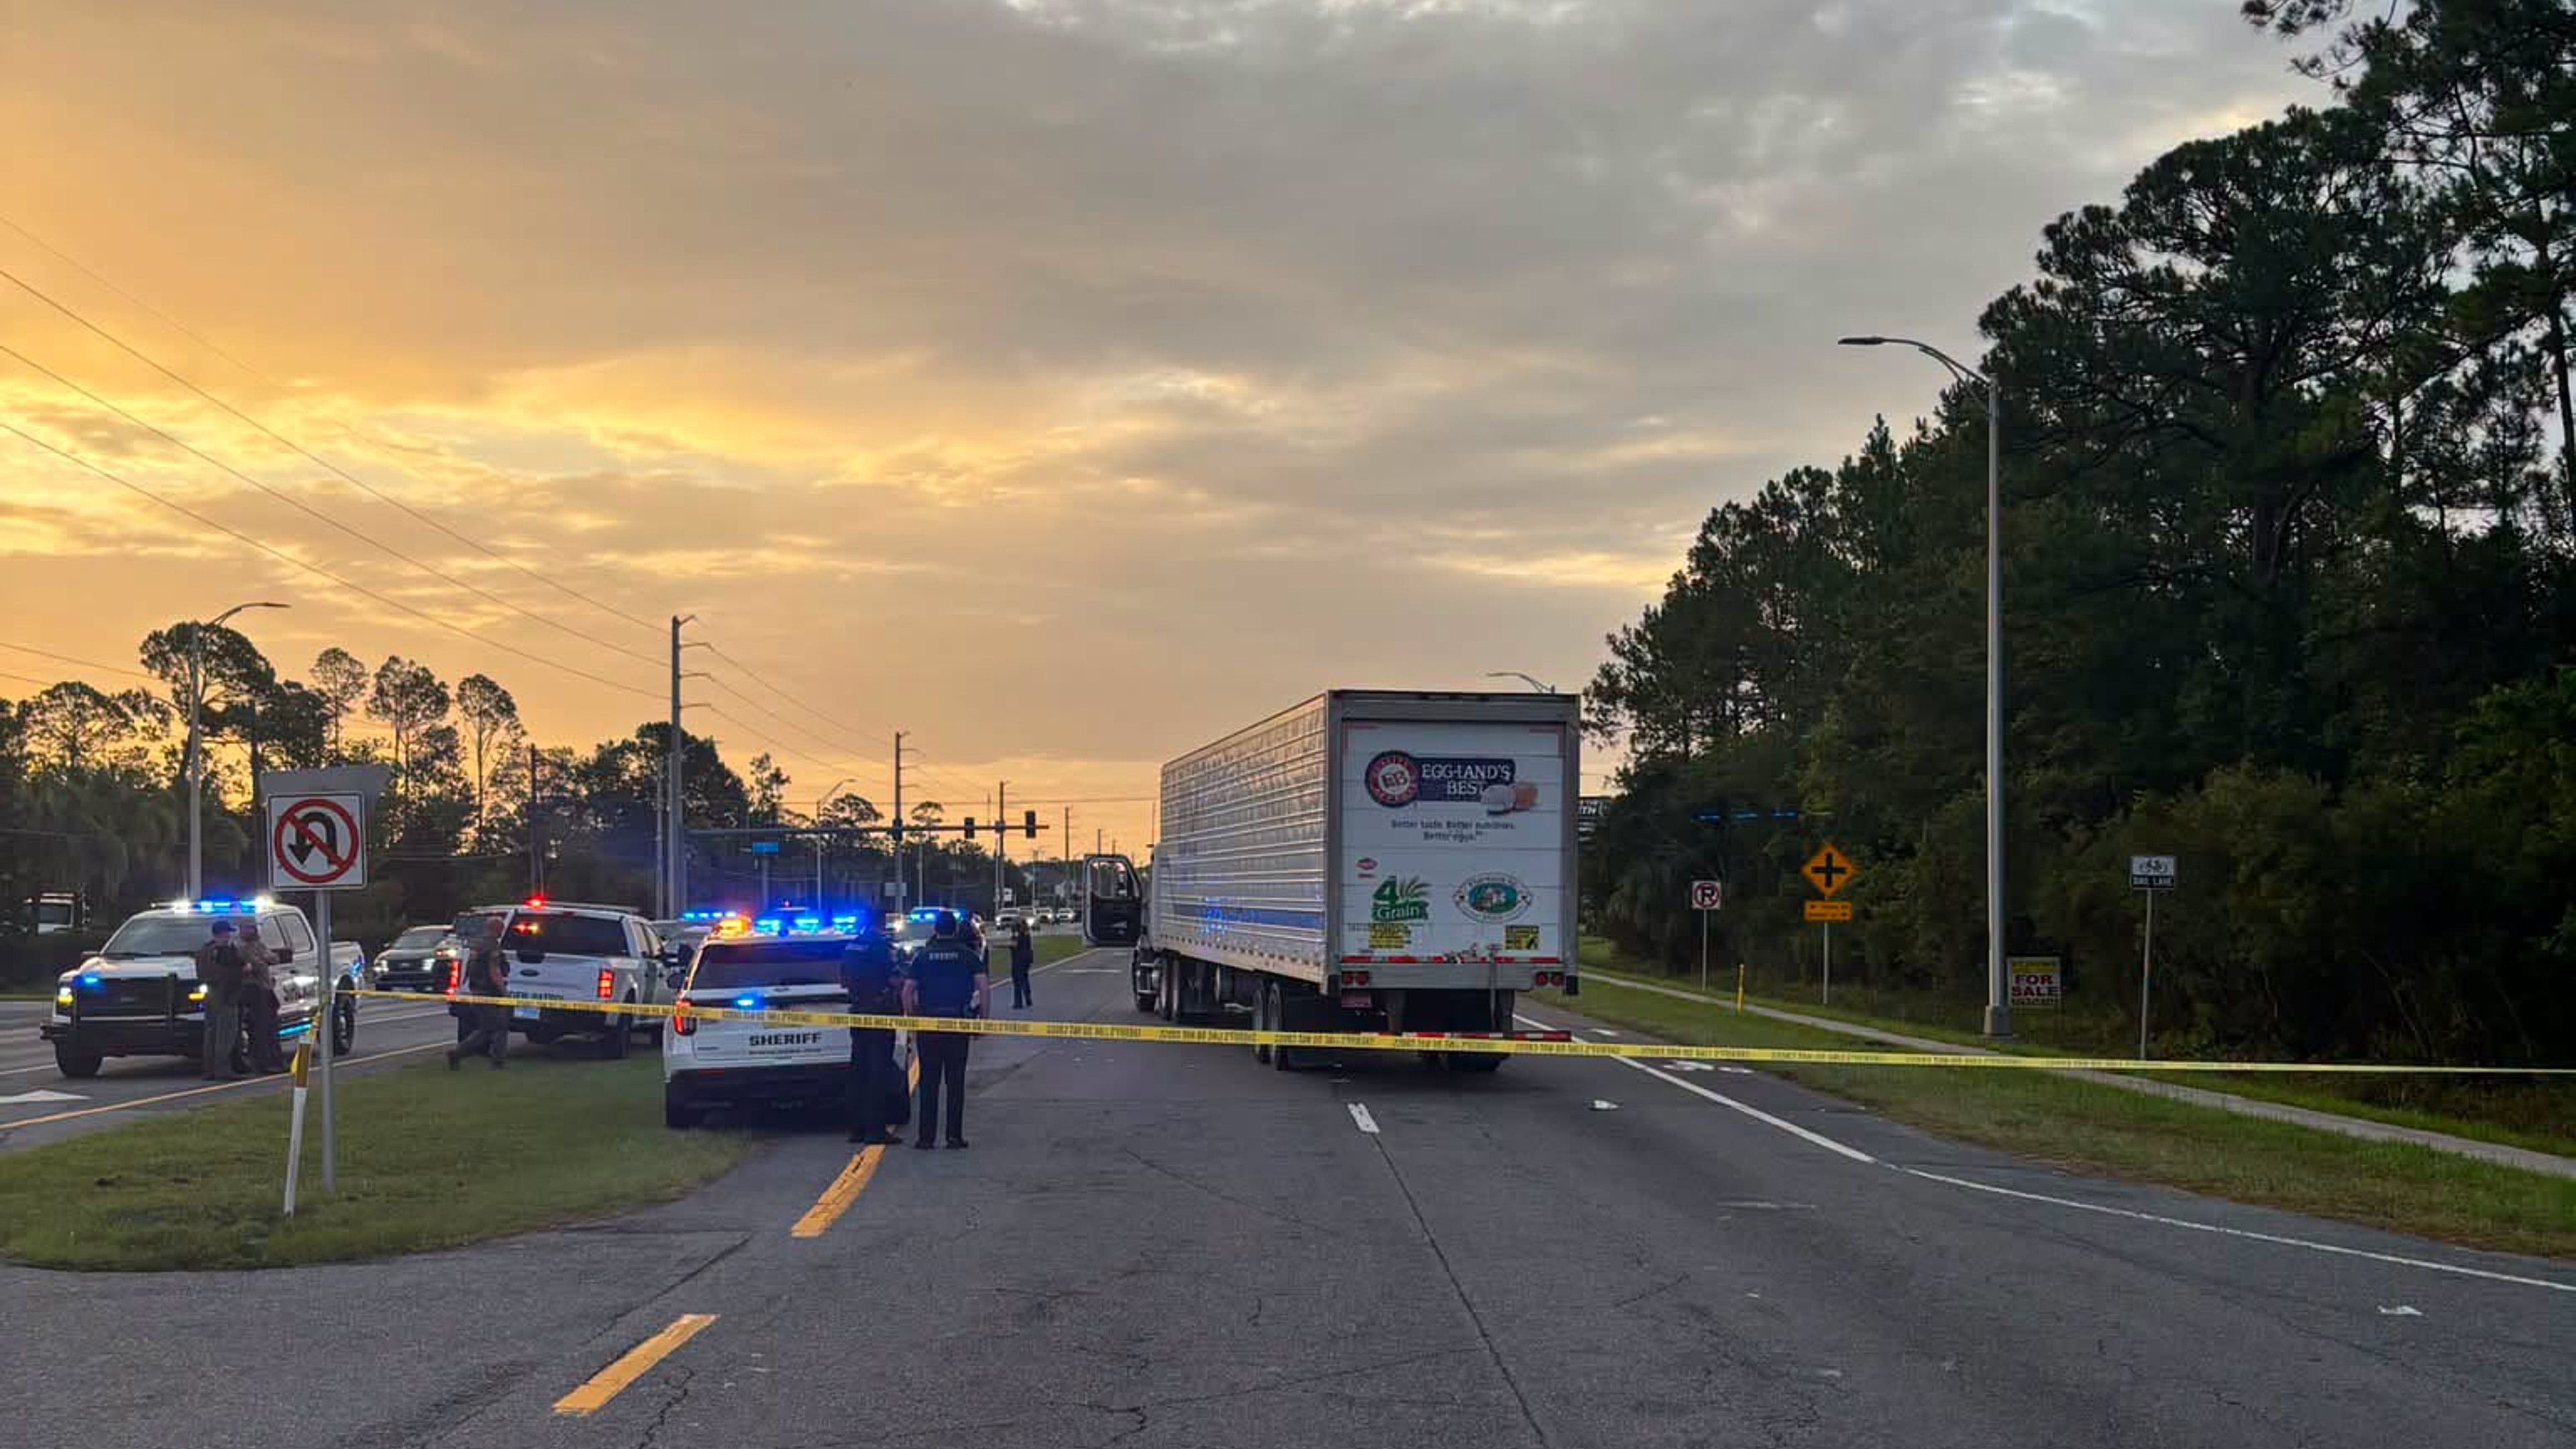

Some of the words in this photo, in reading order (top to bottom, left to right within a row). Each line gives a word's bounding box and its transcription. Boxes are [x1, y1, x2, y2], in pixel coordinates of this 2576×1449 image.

[1373, 876, 1399, 908] 4
[1377, 904, 1420, 920] Grain
[2015, 974, 2053, 985] FOR
[2012, 985, 2059, 998] SALE
[749, 1032, 821, 1046] SHERIFF
